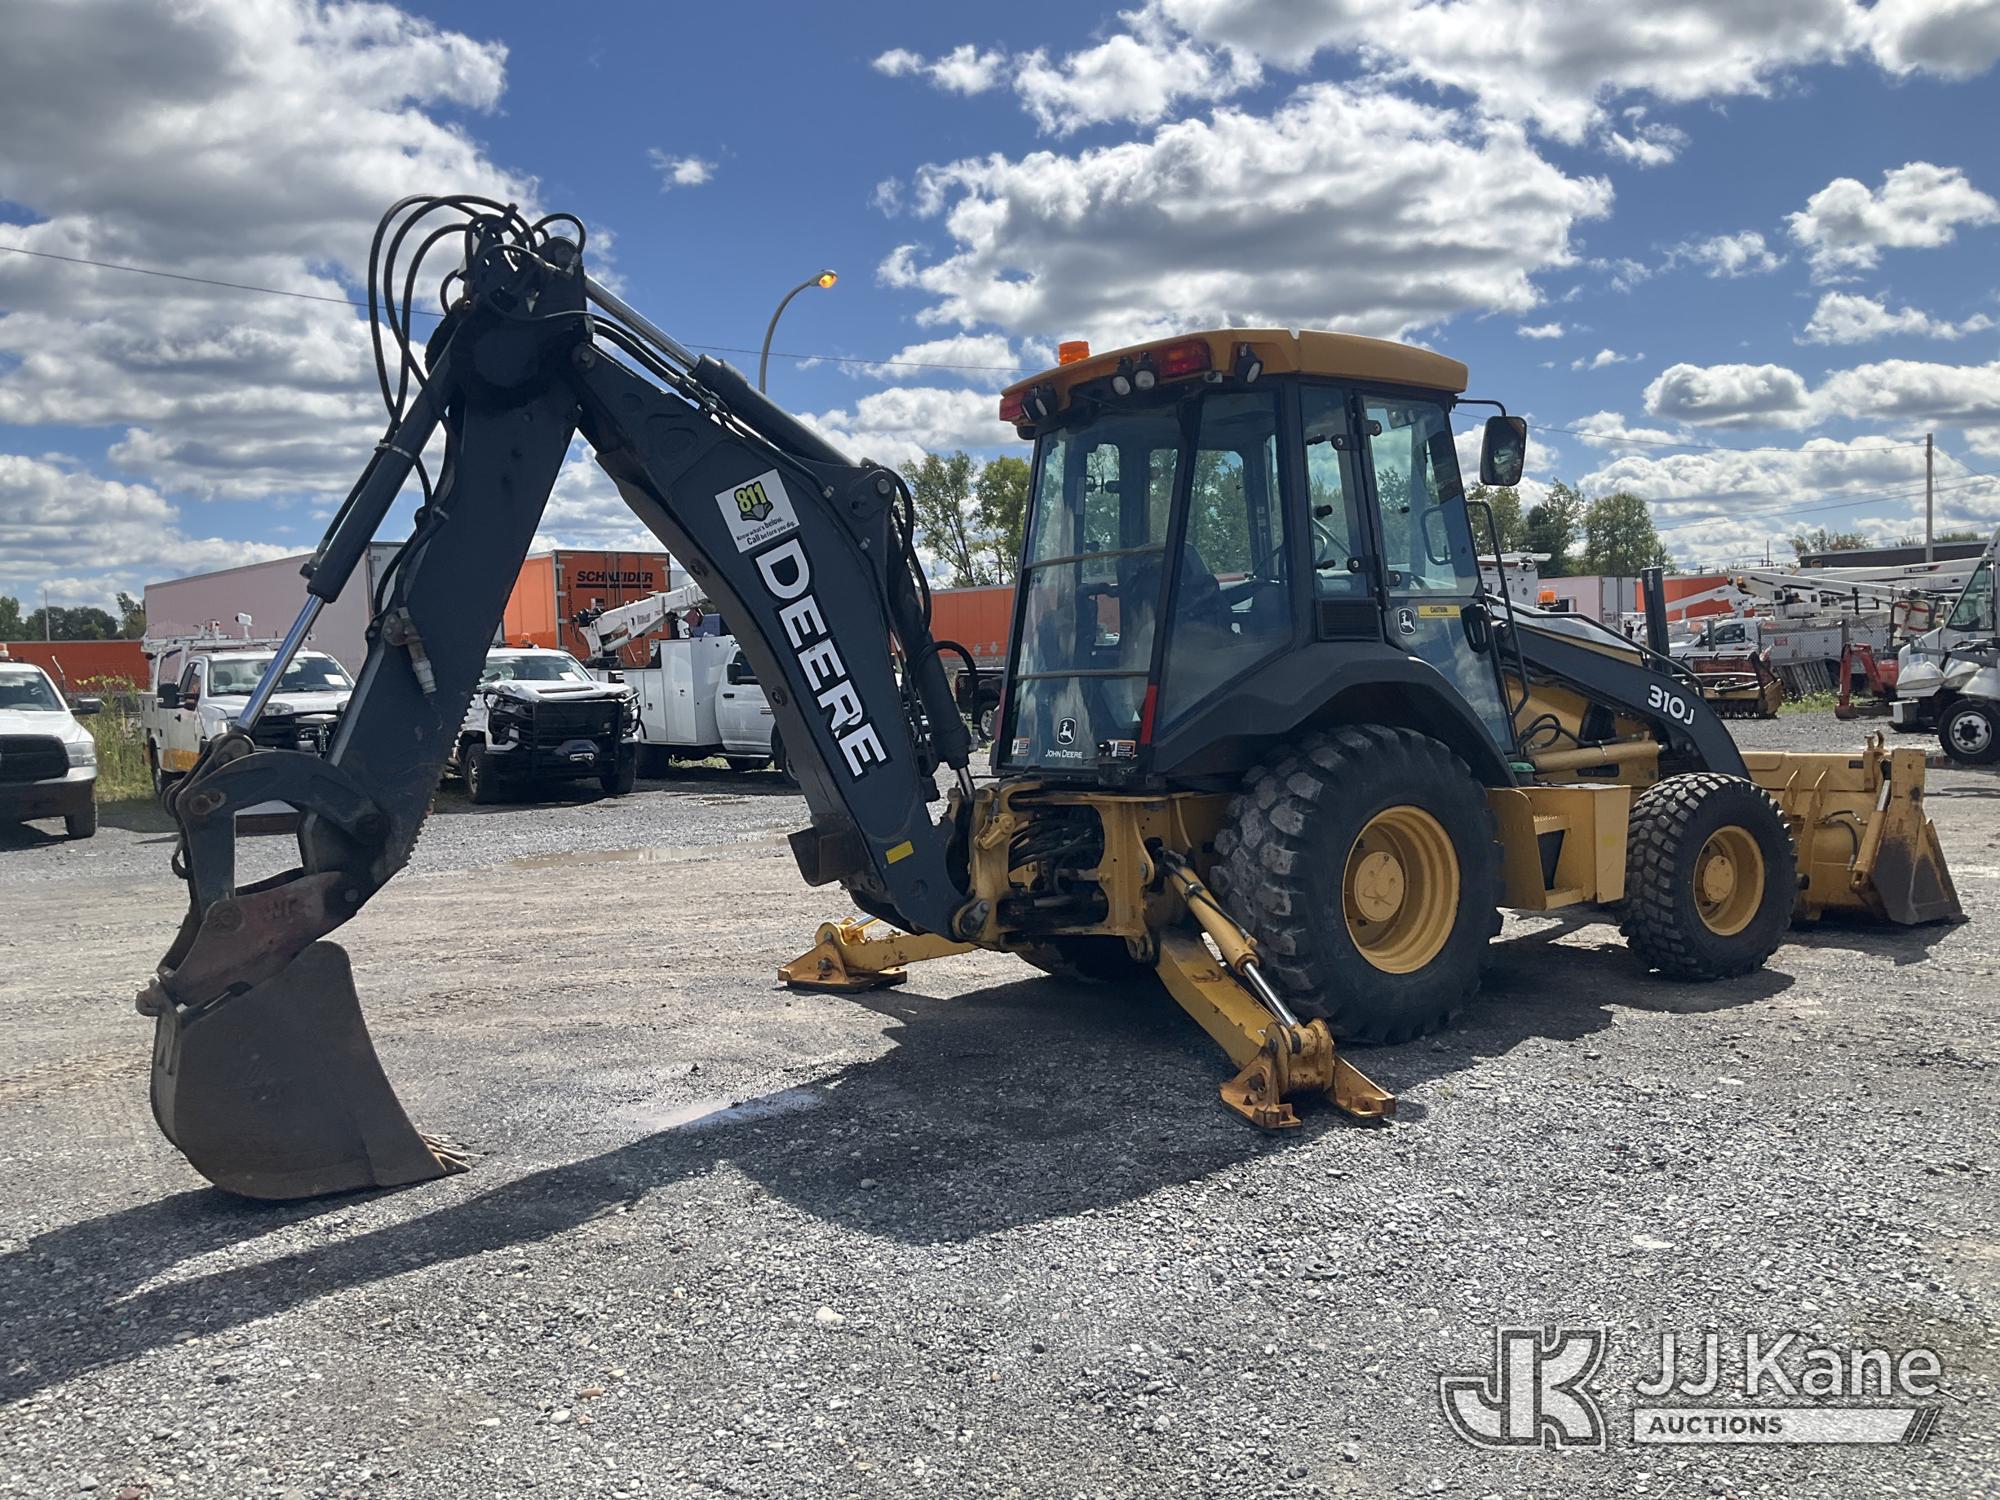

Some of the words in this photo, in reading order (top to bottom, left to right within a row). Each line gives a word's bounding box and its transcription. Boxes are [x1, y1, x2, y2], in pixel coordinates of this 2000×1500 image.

[734, 481, 768, 513] 811
[746, 534, 760, 545] Call
[760, 530, 777, 540] before
[577, 571, 653, 582] SCHNEIDER
[755, 538, 887, 777] DEERE
[1648, 684, 1694, 725] 310J
[1045, 749, 1061, 757] JOHN
[1061, 749, 1083, 758] DEERE
